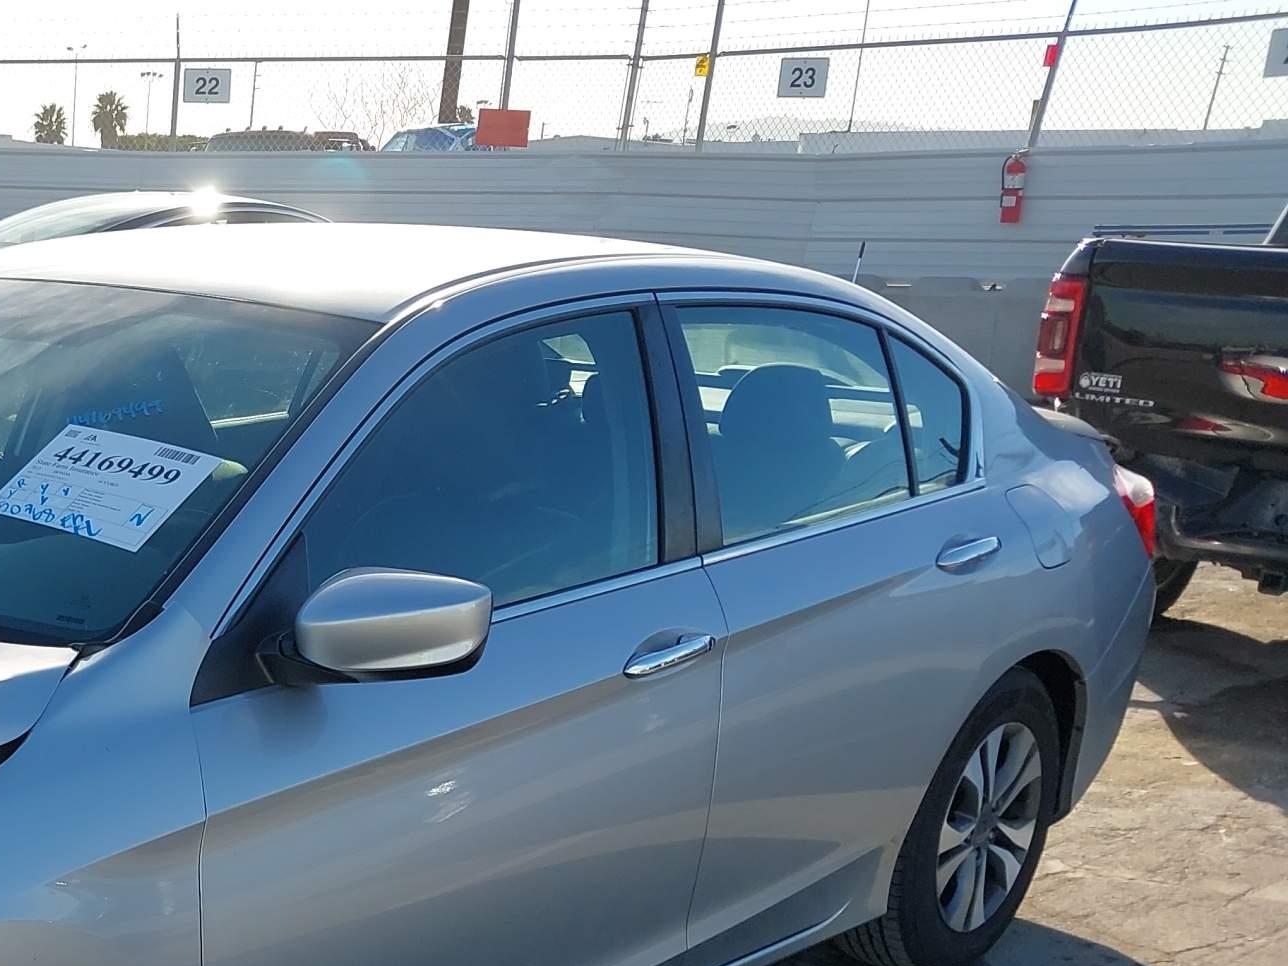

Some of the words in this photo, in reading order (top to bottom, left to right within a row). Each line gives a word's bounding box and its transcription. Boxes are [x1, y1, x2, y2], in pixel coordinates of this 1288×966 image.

[195, 77, 220, 95] 22
[790, 67, 816, 88] 23
[1091, 376, 1122, 388] YETI
[1075, 392, 1154, 407] LIMITED
[54, 446, 181, 485] 44169499
